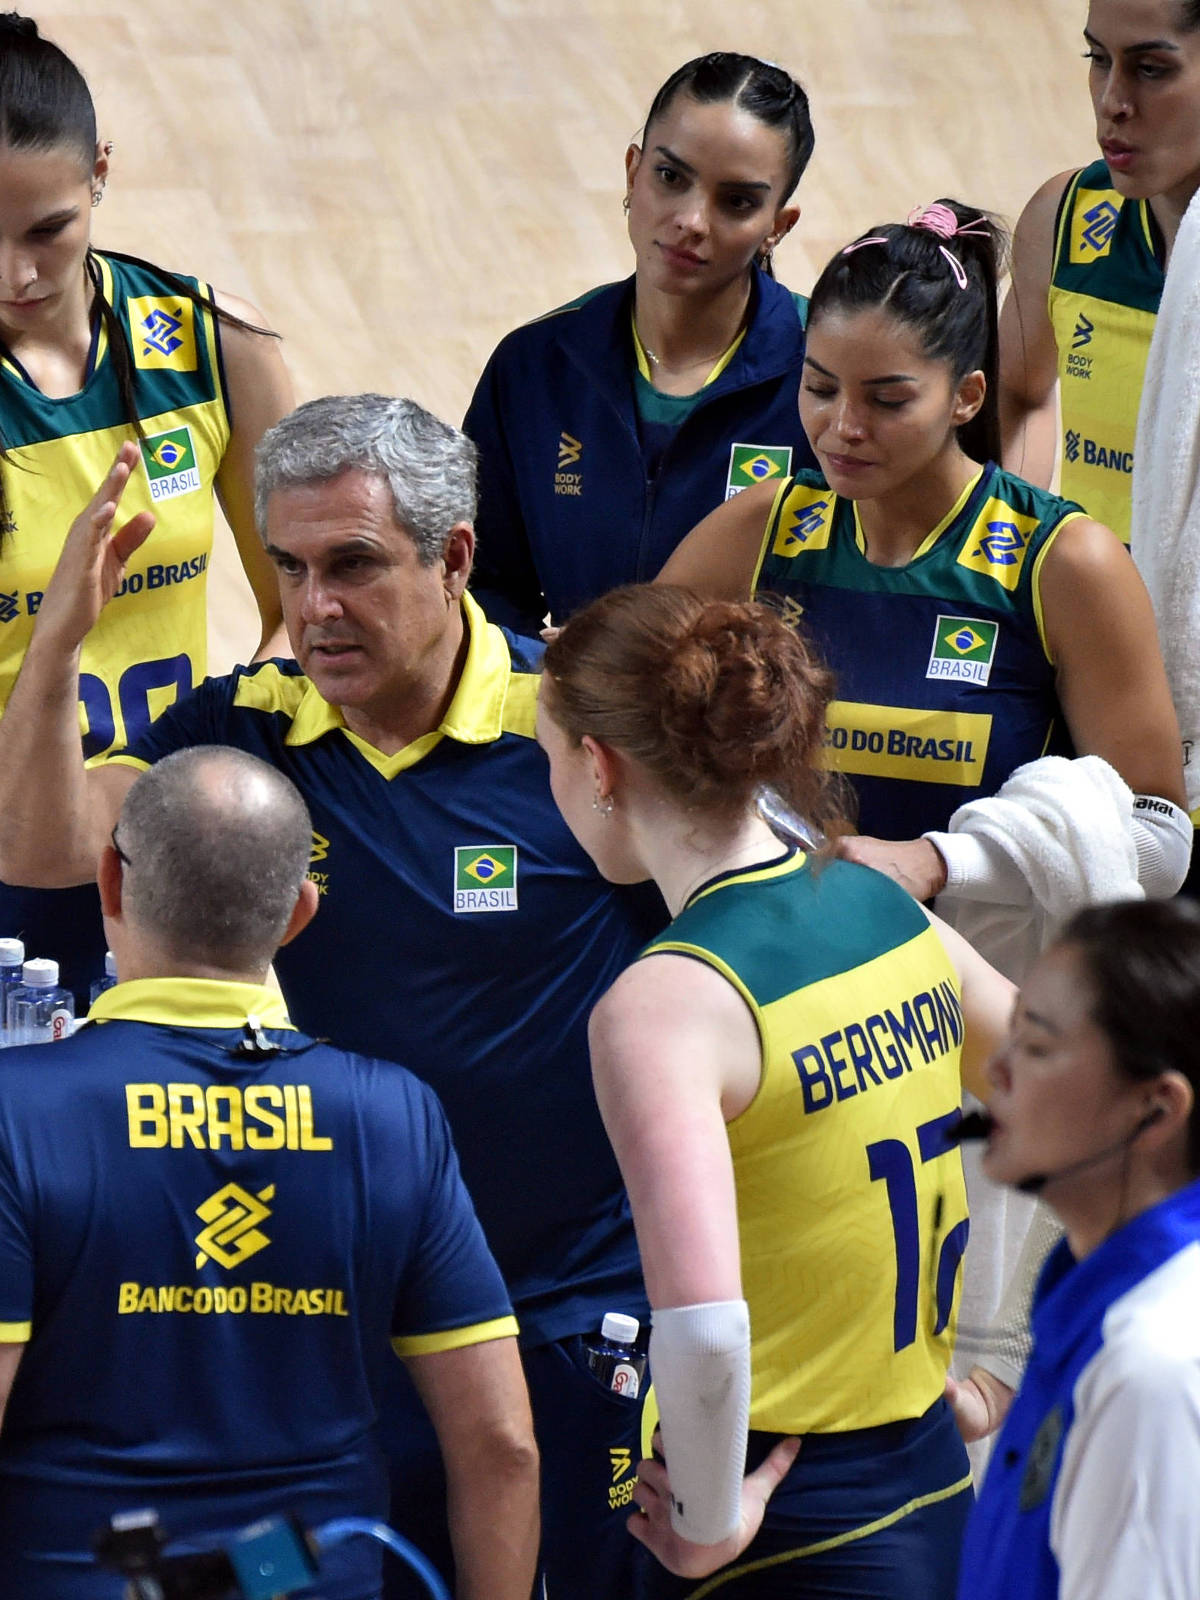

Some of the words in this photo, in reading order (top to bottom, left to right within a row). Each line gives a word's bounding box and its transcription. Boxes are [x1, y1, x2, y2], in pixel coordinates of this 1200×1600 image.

[1065, 365, 1091, 380] WORK
[1067, 354, 1093, 369] BODY
[1083, 439, 1134, 474] BANC
[150, 471, 199, 499] BRASIL
[554, 472, 582, 485] BODY
[554, 484, 582, 496] WORK
[146, 553, 207, 590] BRASIL
[928, 659, 987, 682] BRASIL
[851, 730, 884, 753] DO
[887, 729, 976, 763] BRASIL
[456, 889, 516, 909] BRASIL
[125, 1083, 333, 1151] BRASIL
[250, 1282, 349, 1316] BRASIL
